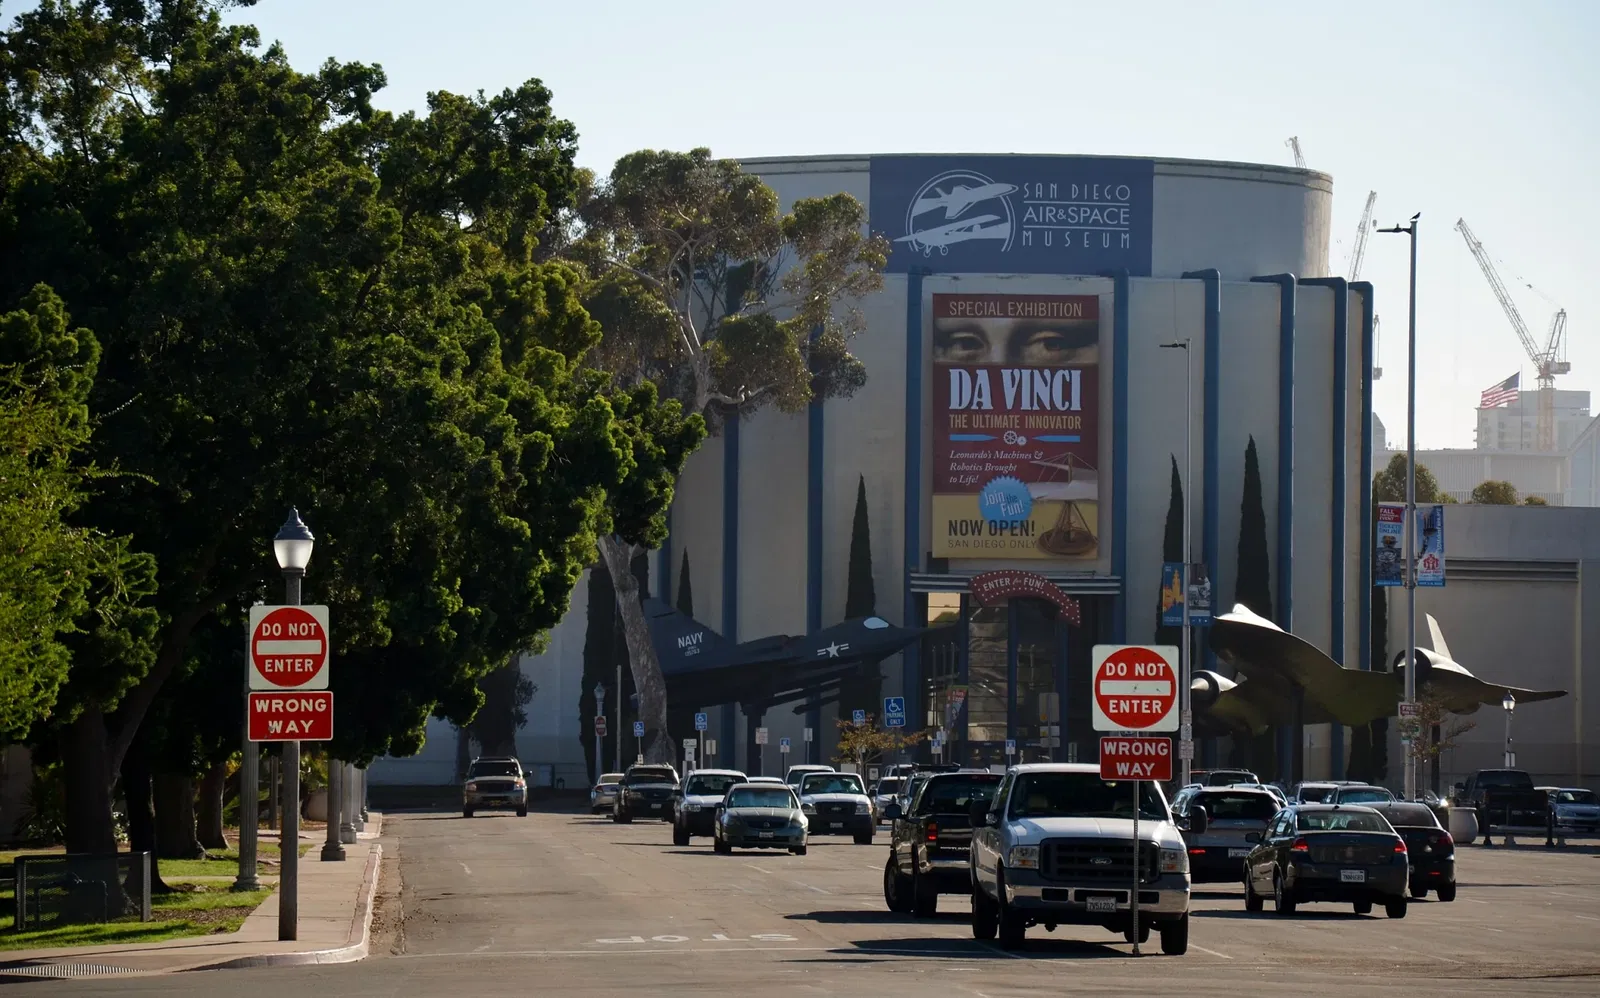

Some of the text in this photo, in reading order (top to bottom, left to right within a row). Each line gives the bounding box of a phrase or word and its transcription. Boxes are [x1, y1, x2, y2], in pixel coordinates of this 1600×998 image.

[1023, 183, 1131, 201] SAN DIEGO
[1023, 206, 1130, 225] AIR&SPACE
[1022, 231, 1130, 249] MUSEUM
[949, 301, 1082, 317] SPECIAL EXHIBITION
[949, 368, 1082, 411] DA VINCI
[949, 414, 1081, 430] THE ULTIMATE INNOVATOR
[949, 450, 1044, 459] Leonardo's Machines &
[949, 463, 1017, 473] Robotics Brought
[959, 475, 979, 486] Life!
[984, 491, 1018, 507] Join the
[1001, 500, 1024, 517] Fun!
[948, 519, 1035, 537] NOW OPEN!
[948, 539, 1038, 549] SAN DIEGO ONLY
[982, 577, 1011, 592] ENTER
[1023, 577, 1045, 590] FUN!
[262, 623, 317, 636] DO NOT
[677, 631, 703, 649] NAVY
[264, 659, 314, 673] ENTER
[1105, 662, 1166, 677] DO NOT
[255, 698, 327, 713] WRONG
[1109, 700, 1162, 714] ENTER
[268, 719, 314, 734] WAY
[1103, 741, 1169, 756] WRONG
[1115, 762, 1156, 776] WAY
